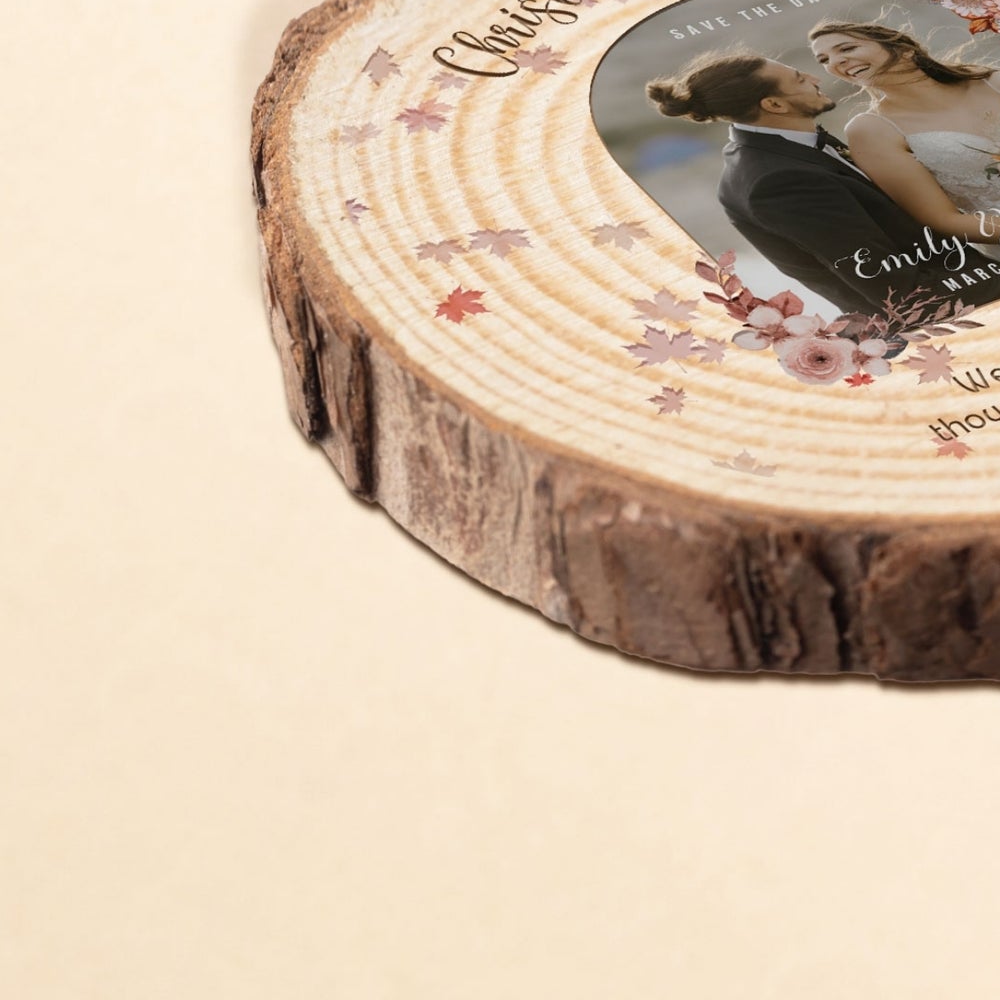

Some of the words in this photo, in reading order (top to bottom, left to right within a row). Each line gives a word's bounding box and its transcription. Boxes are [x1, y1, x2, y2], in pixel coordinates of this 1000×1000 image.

[669, 15, 731, 41] SAVE
[737, 2, 783, 22] THE
[833, 225, 969, 280] Emily
